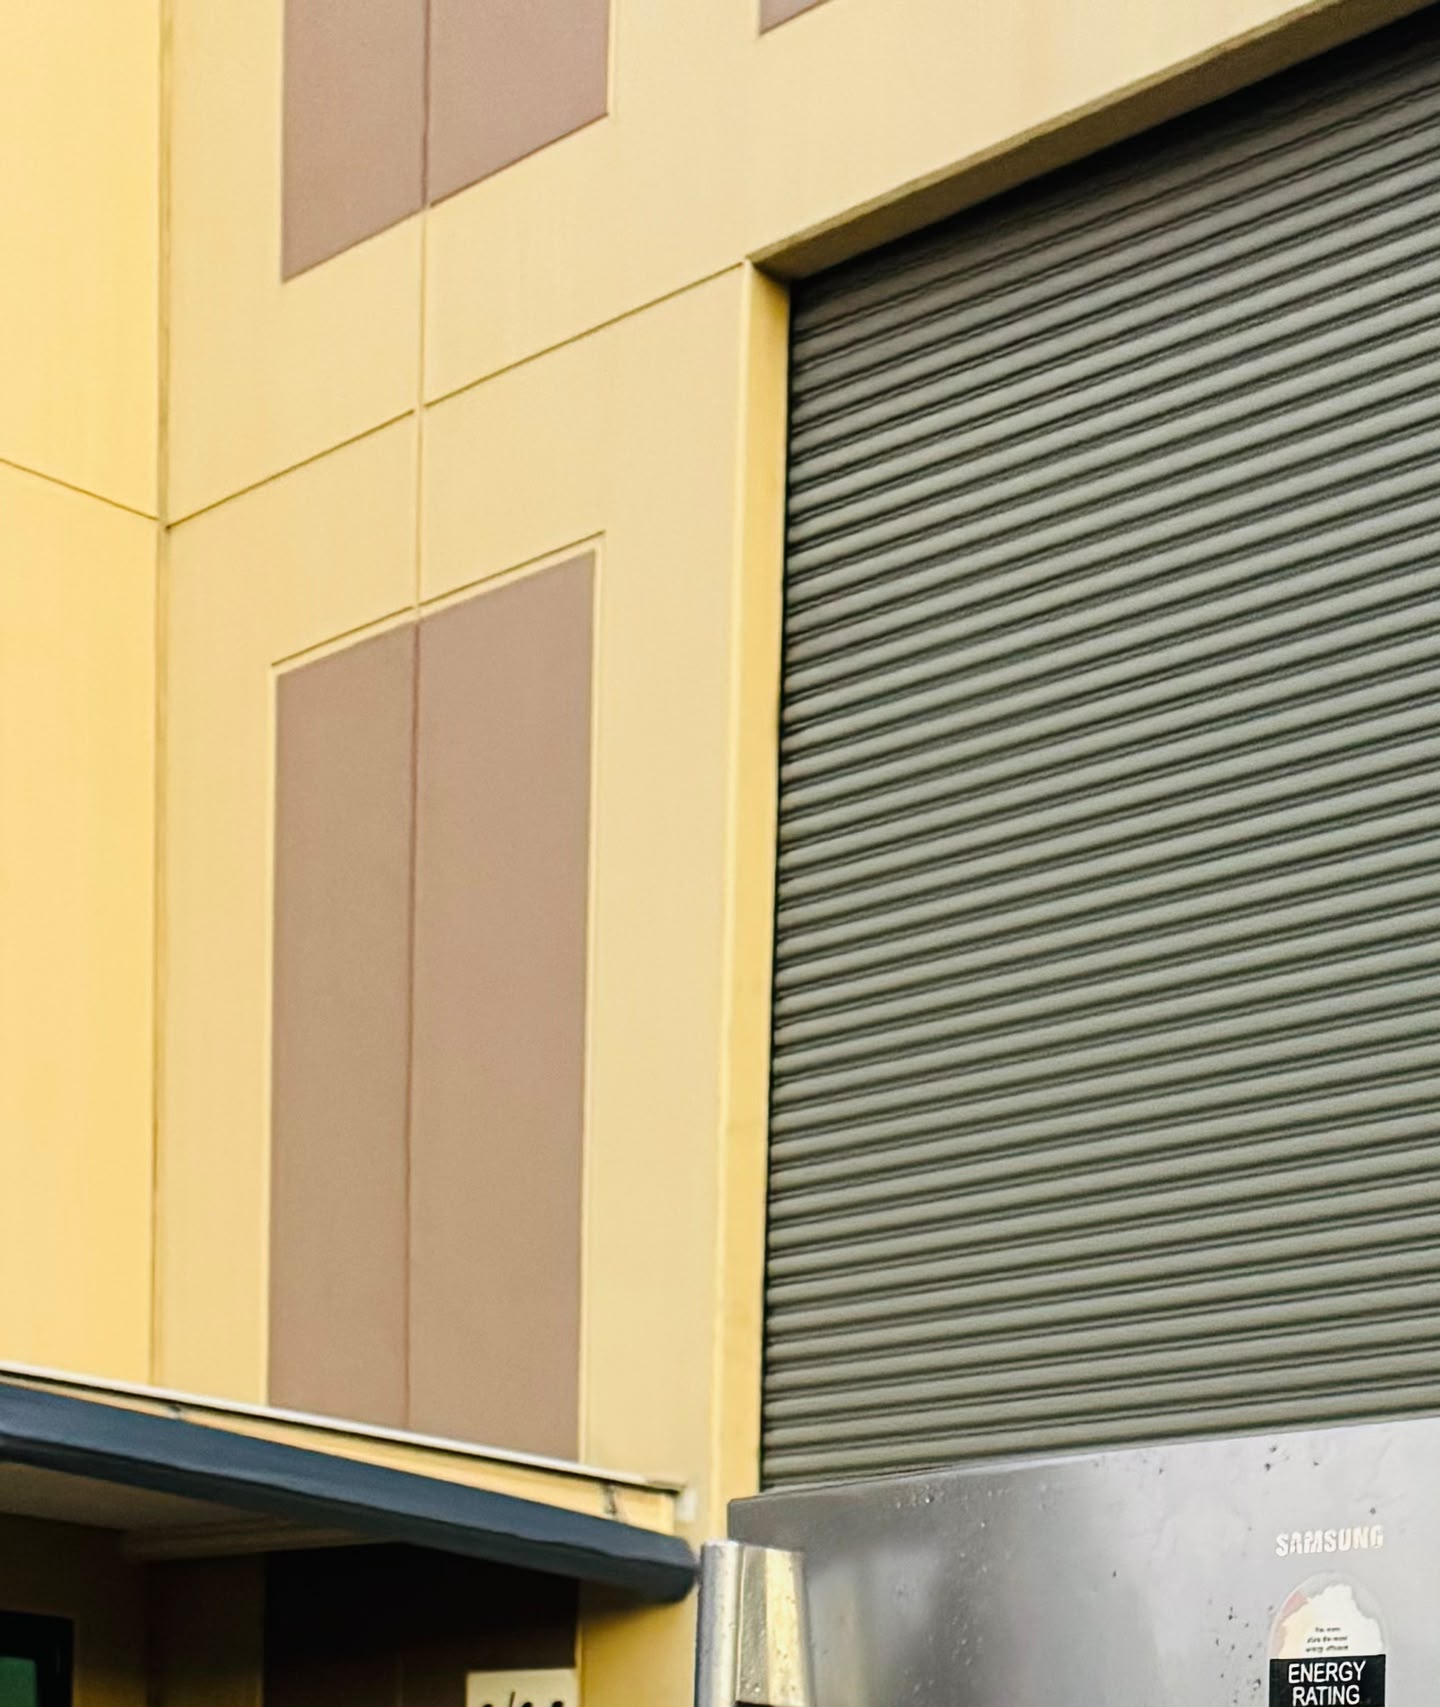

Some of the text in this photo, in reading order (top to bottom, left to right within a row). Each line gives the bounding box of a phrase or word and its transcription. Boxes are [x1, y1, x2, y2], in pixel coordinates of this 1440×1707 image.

[1276, 1524, 1384, 1557] SAMSUNG
[1288, 1660, 1367, 1684] ENERGY
[1292, 1684, 1361, 1707] RATING
